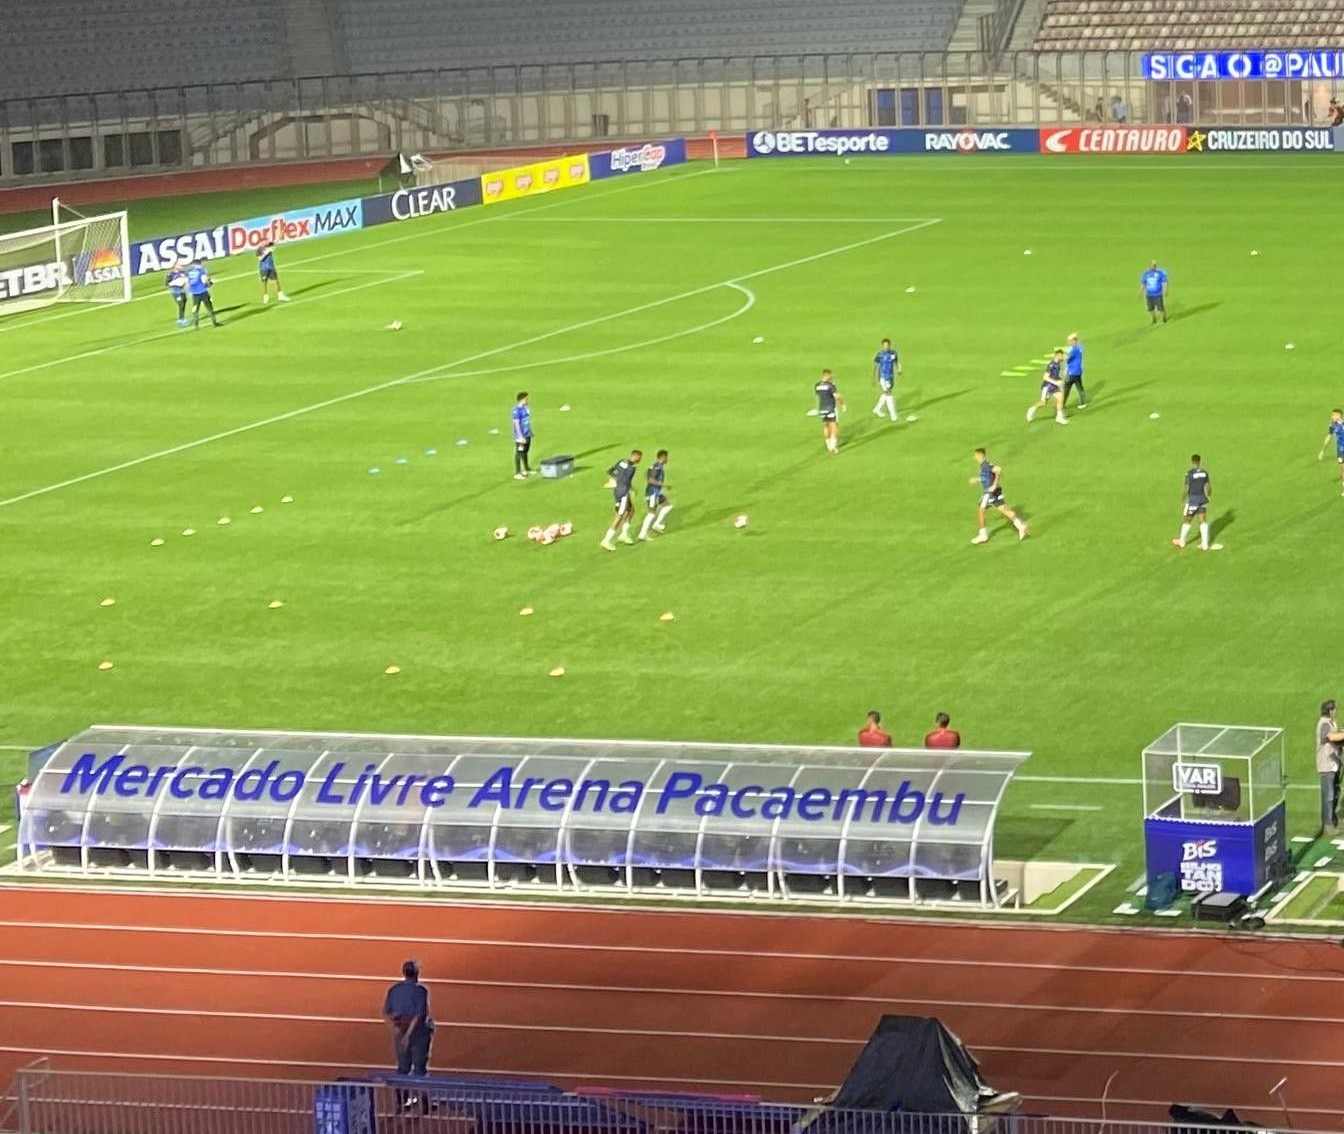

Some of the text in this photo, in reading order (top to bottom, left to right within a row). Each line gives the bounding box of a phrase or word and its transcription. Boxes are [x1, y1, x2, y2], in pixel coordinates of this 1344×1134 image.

[1228, 54, 1251, 79] O
[776, 131, 889, 155] BETesporte
[925, 131, 1011, 152] RAYOVAC
[1078, 128, 1183, 153] CENTAURO
[1208, 129, 1334, 150] CRUZEIRO DO SUL
[391, 186, 457, 220] CLEAR
[230, 205, 358, 251] Dorflex MAX
[85, 266, 122, 286] ASSA
[1178, 767, 1217, 784] VAR
[61, 753, 965, 827] Mercado Livre Arena Pacaembu
